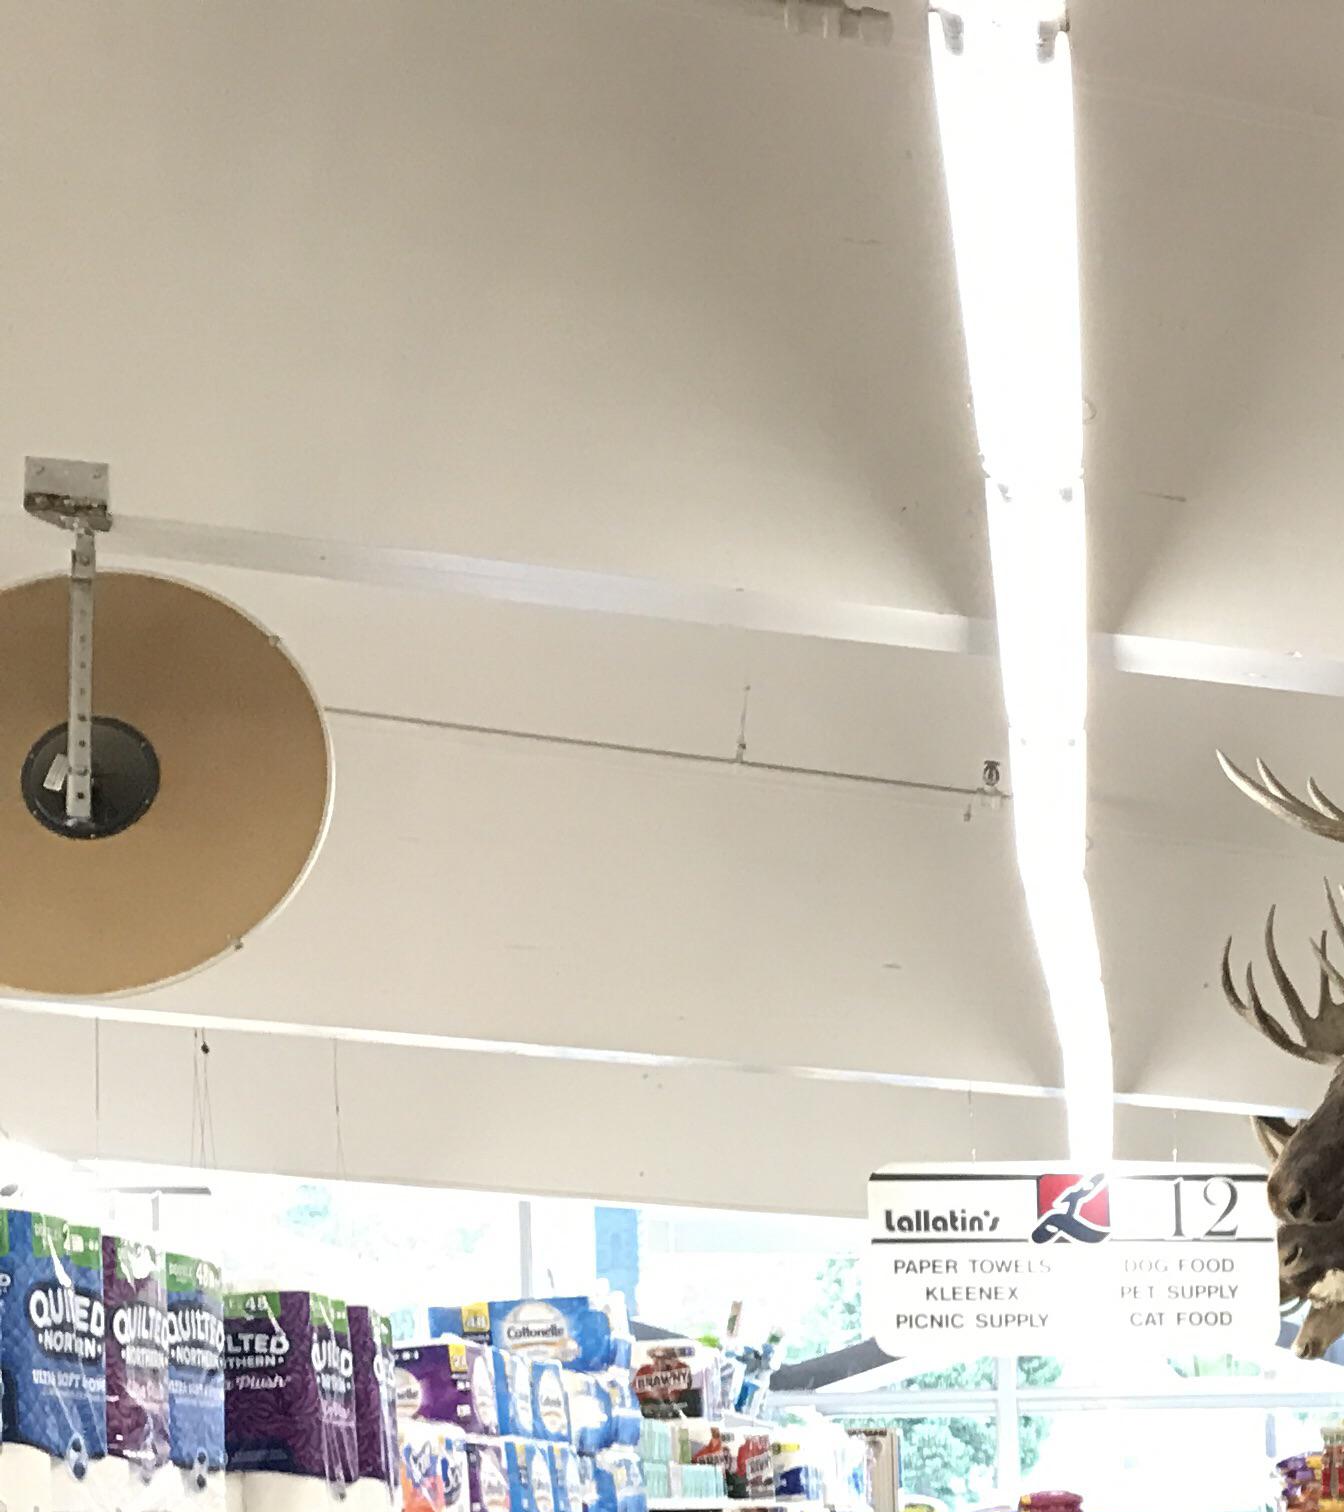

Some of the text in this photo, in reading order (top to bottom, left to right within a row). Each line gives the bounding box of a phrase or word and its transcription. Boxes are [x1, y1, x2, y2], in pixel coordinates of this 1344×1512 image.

[1170, 1175, 1240, 1240] 12
[893, 1258, 1053, 1275] PAPER TOWELS
[1123, 1257, 1236, 1274] DOG FOOD
[925, 1285, 1019, 1301] KLEENEX
[1120, 1284, 1239, 1300] PET SUPPLY
[895, 1312, 1049, 1330] PICNIC SUPPLY
[1130, 1311, 1234, 1327] CAT FOOD
[226, 1332, 290, 1355] LTED
